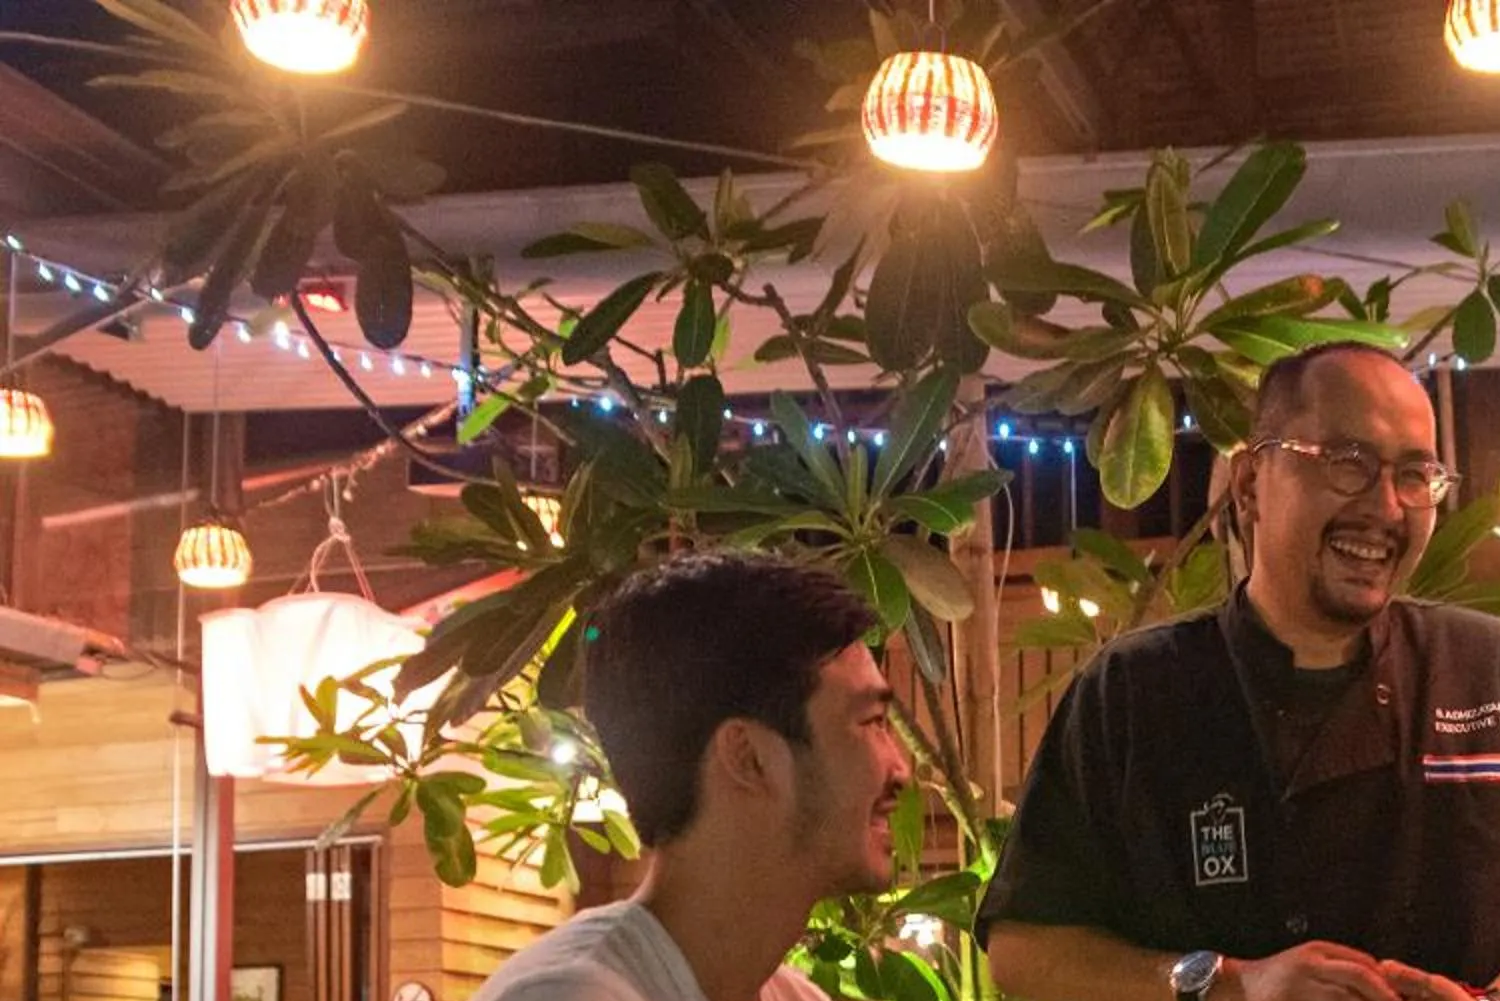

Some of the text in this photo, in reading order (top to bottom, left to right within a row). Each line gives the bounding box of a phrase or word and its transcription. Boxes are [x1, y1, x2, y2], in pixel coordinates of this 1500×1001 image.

[1435, 716, 1496, 733] EXECUTIVE
[1200, 825, 1233, 842] THE
[1204, 855, 1236, 878] OX
